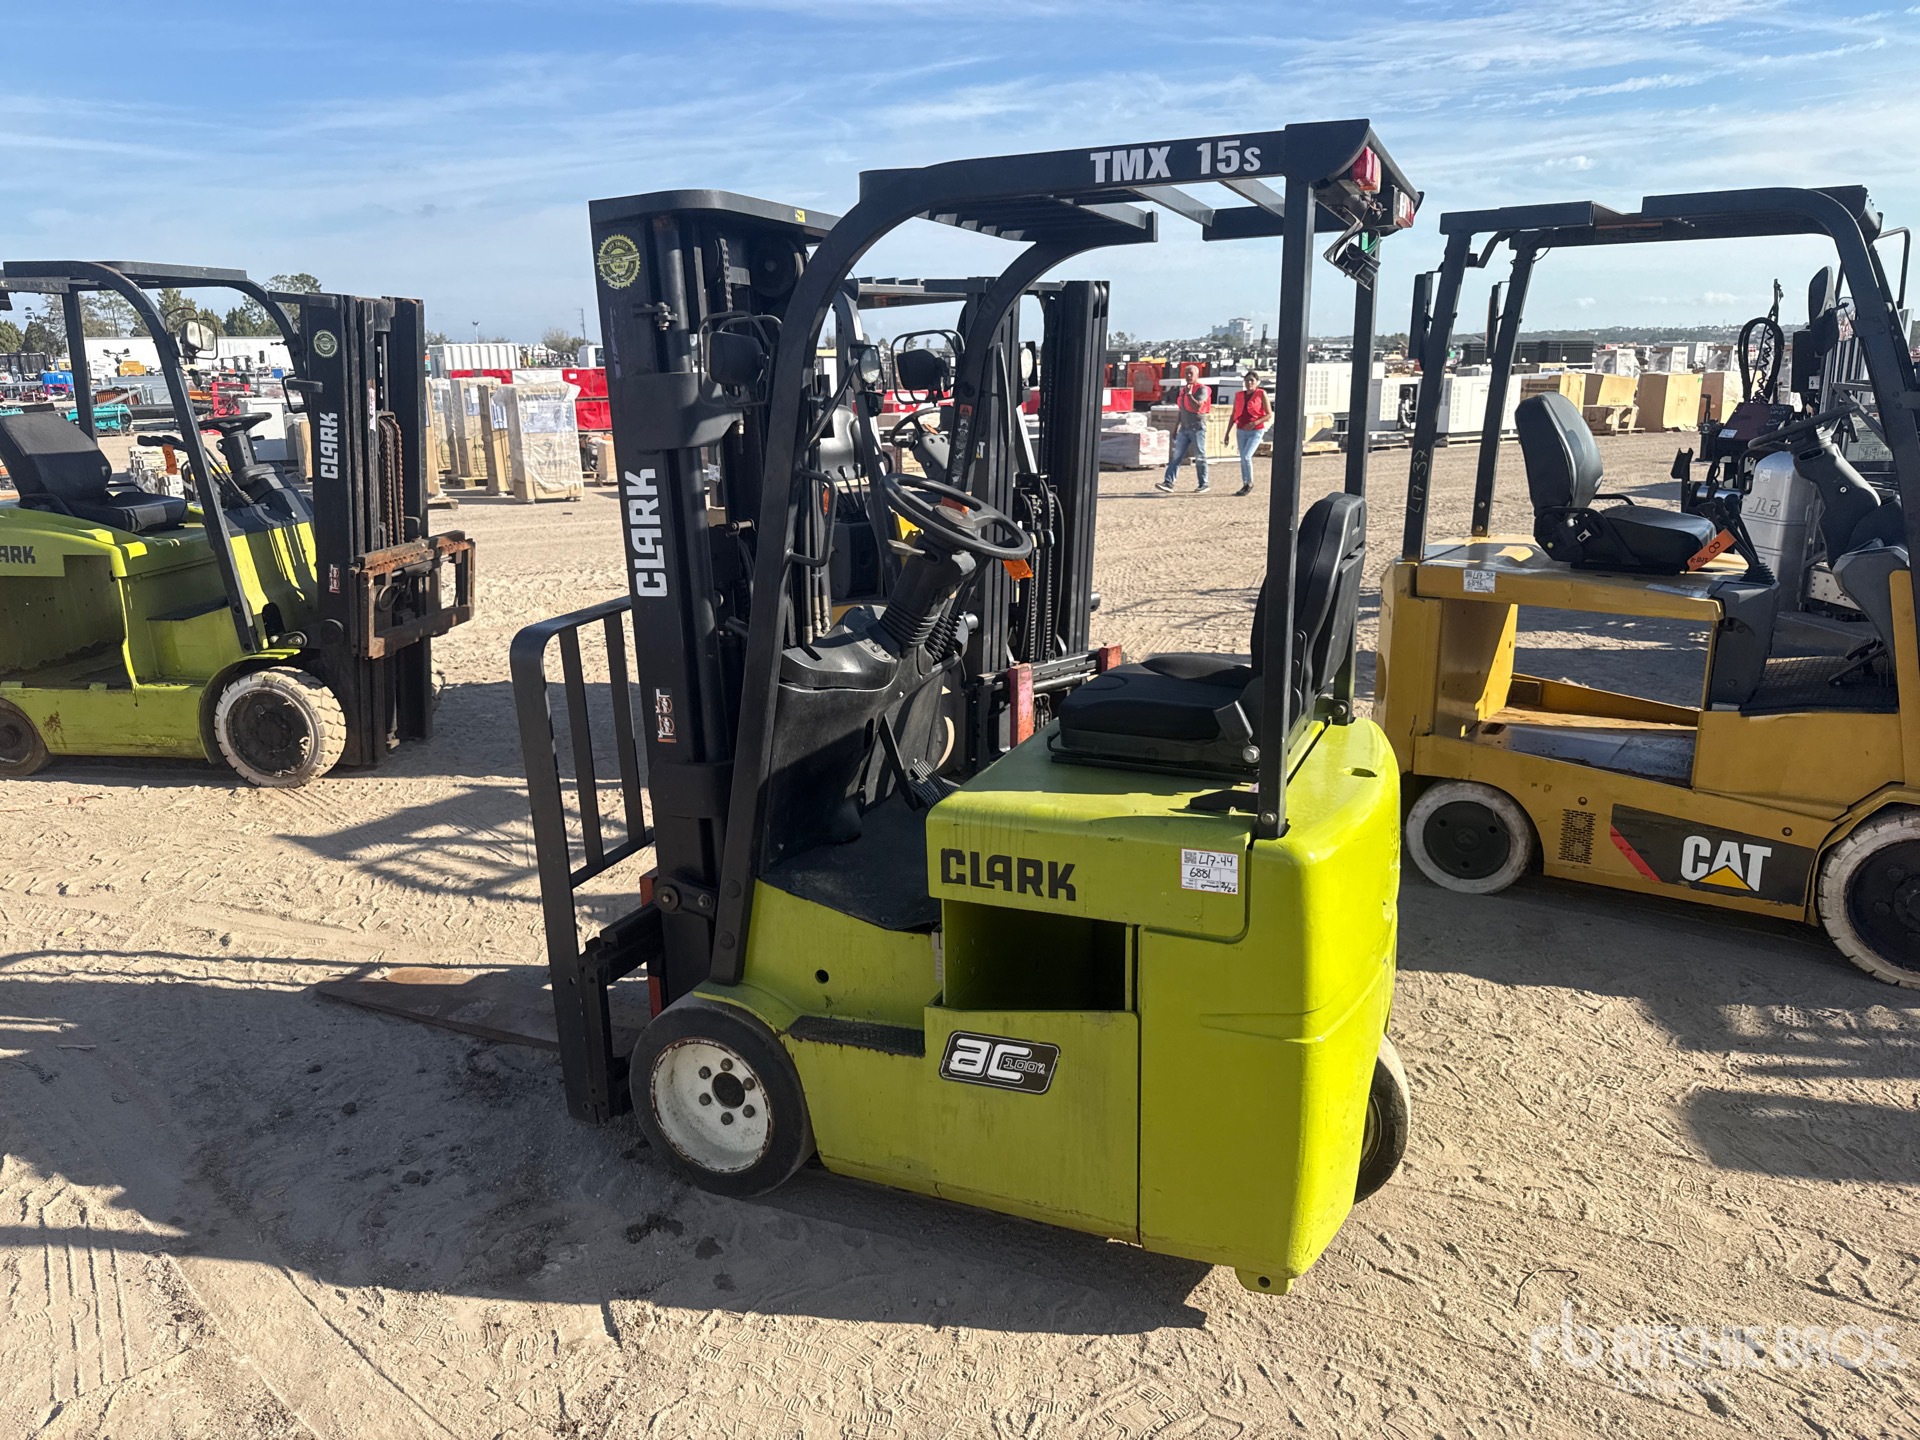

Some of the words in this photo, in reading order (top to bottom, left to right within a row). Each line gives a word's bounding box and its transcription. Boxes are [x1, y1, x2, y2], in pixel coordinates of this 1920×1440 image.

[1090, 146, 1171, 183] TMX
[1197, 140, 1261, 175] 15s
[320, 412, 338, 479] CLARK
[1748, 497, 1780, 517] JLG
[624, 468, 668, 597] CLARK
[0, 545, 36, 564] ARK
[941, 848, 1076, 901] CLARK
[1190, 867, 1211, 879] 6881
[1199, 854, 1233, 866] L17-44
[1680, 835, 1772, 892] CAT
